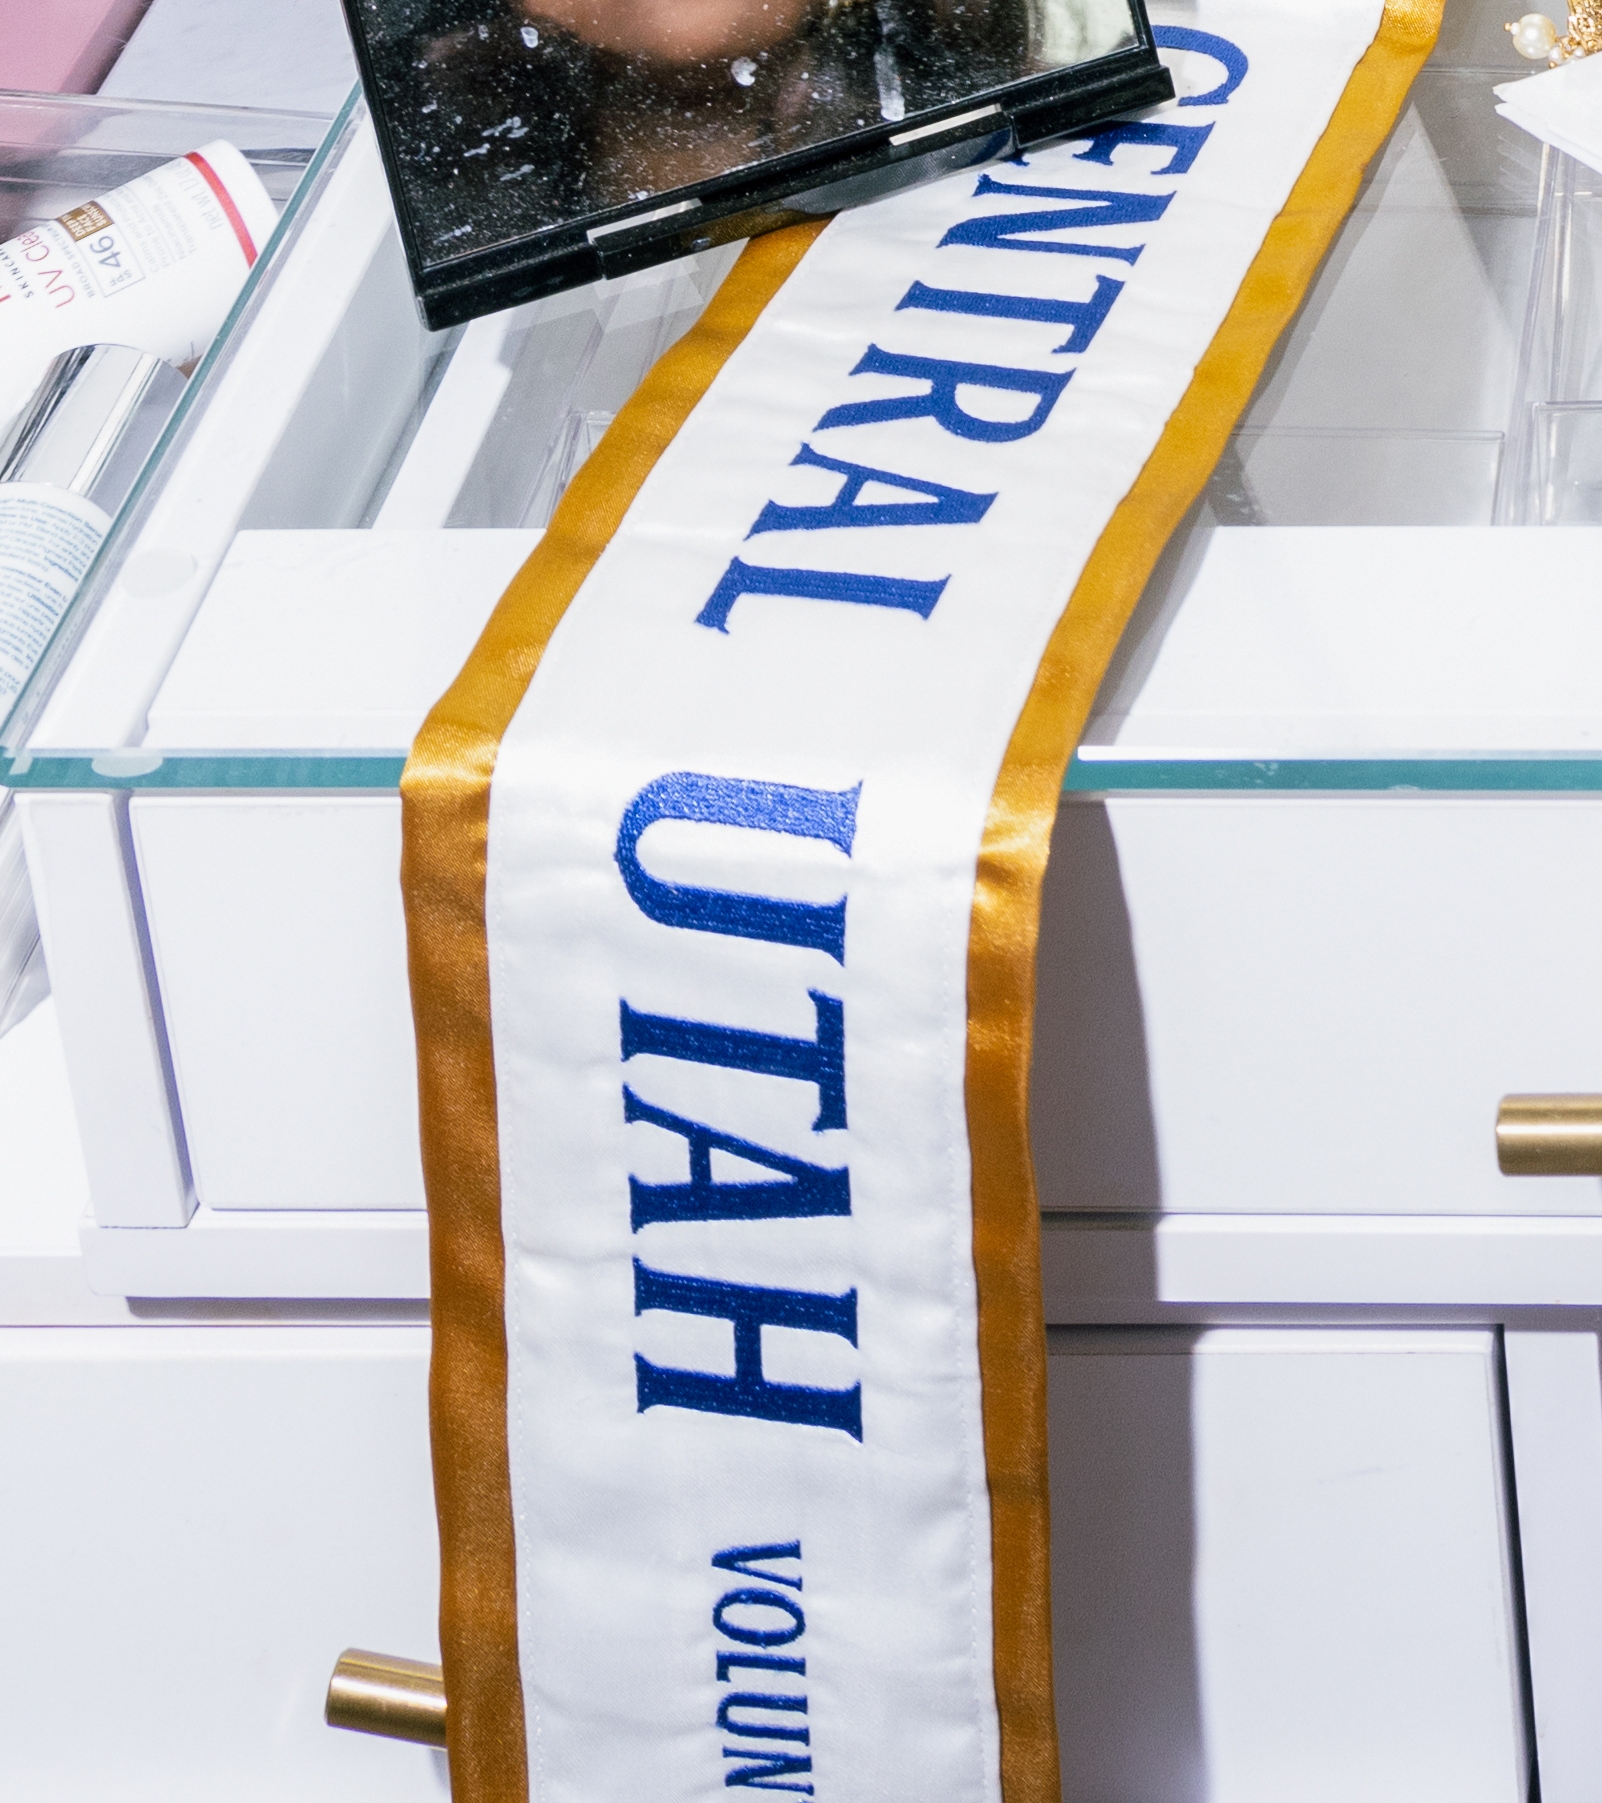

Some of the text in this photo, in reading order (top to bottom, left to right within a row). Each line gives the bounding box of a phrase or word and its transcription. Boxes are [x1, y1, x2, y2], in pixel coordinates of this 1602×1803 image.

[17, 230, 75, 309] UV Clea
[90, 235, 122, 268] 46
[694, 23, 1250, 635] CENTRAL
[613, 771, 864, 1444] UTAH
[711, 1539, 817, 1803] VOLUN
